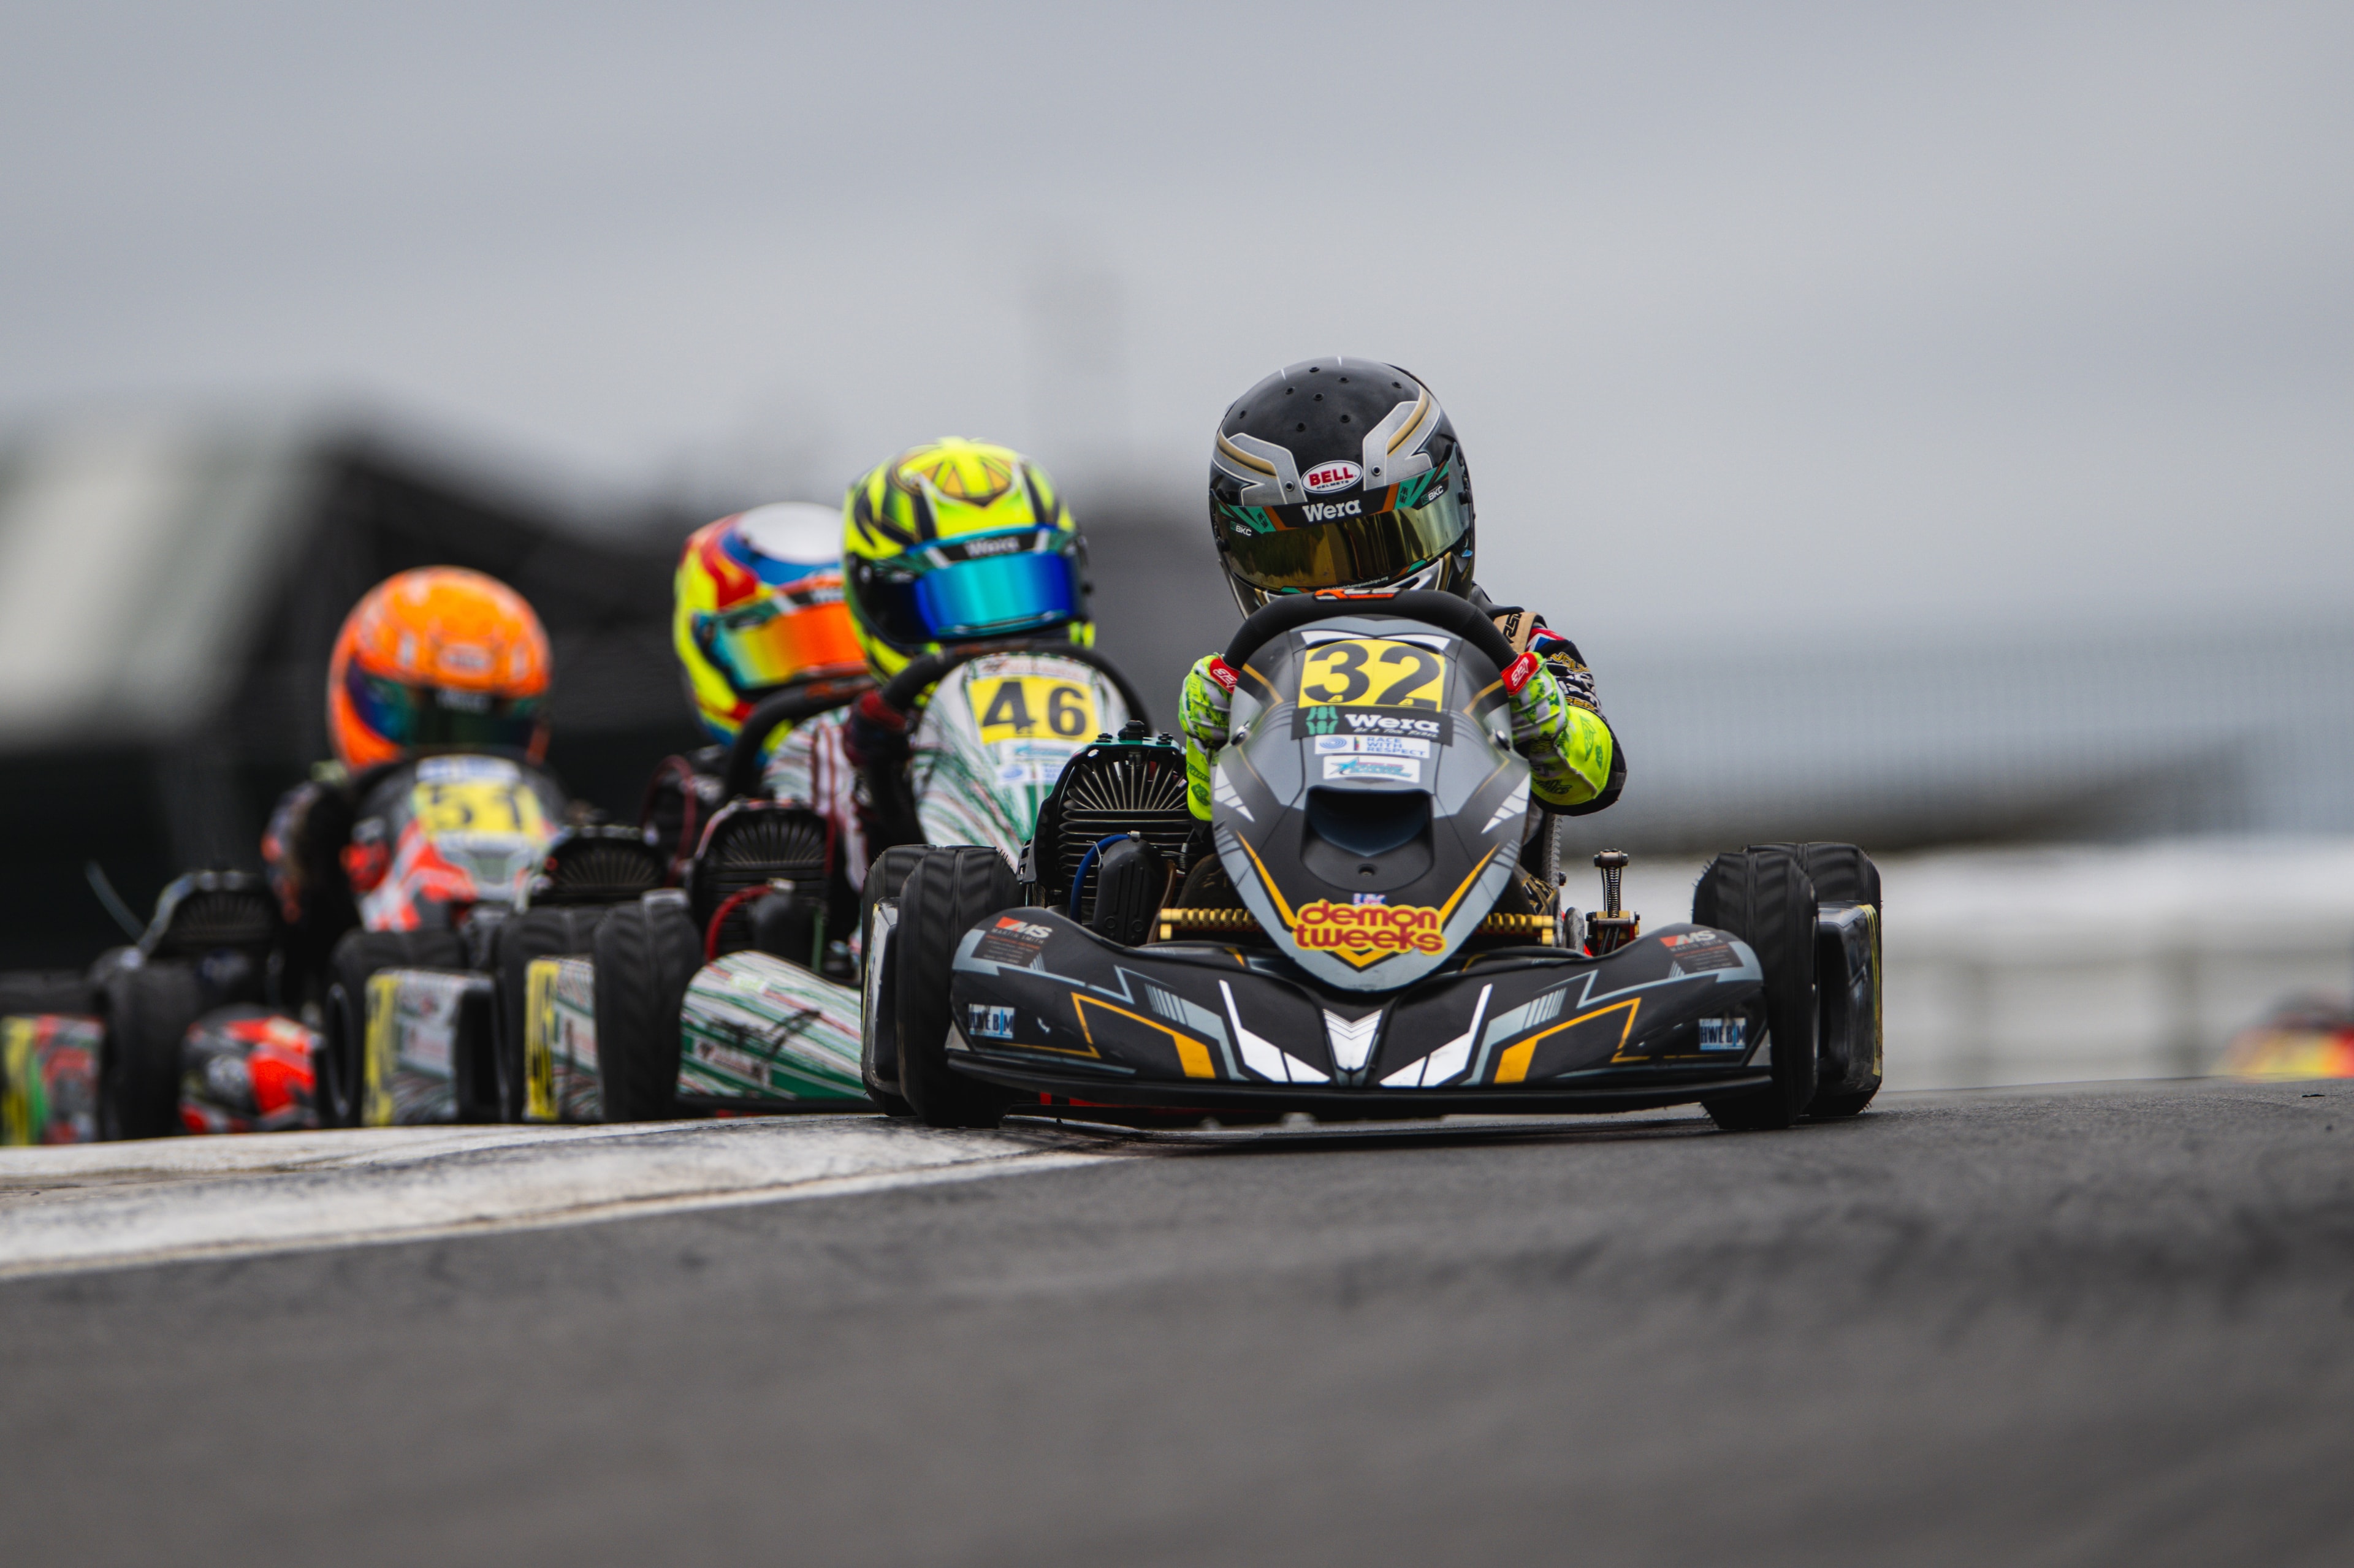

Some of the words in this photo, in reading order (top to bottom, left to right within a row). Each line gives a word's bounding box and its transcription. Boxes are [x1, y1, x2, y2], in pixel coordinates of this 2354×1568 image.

[1308, 466, 1354, 487] BELL
[1317, 479, 1349, 489] HELMETS
[1428, 485, 1444, 501] BKC
[1301, 500, 1362, 522] Wera
[1235, 525, 1252, 536] BKC
[1303, 642, 1441, 710] 32
[981, 682, 1087, 736] 46
[1345, 714, 1440, 733] Wera
[1366, 747, 1426, 756] RESPECT
[1300, 901, 1438, 930] demon
[991, 927, 1019, 938] MARTIN
[1021, 935, 1044, 944] SMITH
[1293, 924, 1444, 952] tweeks
